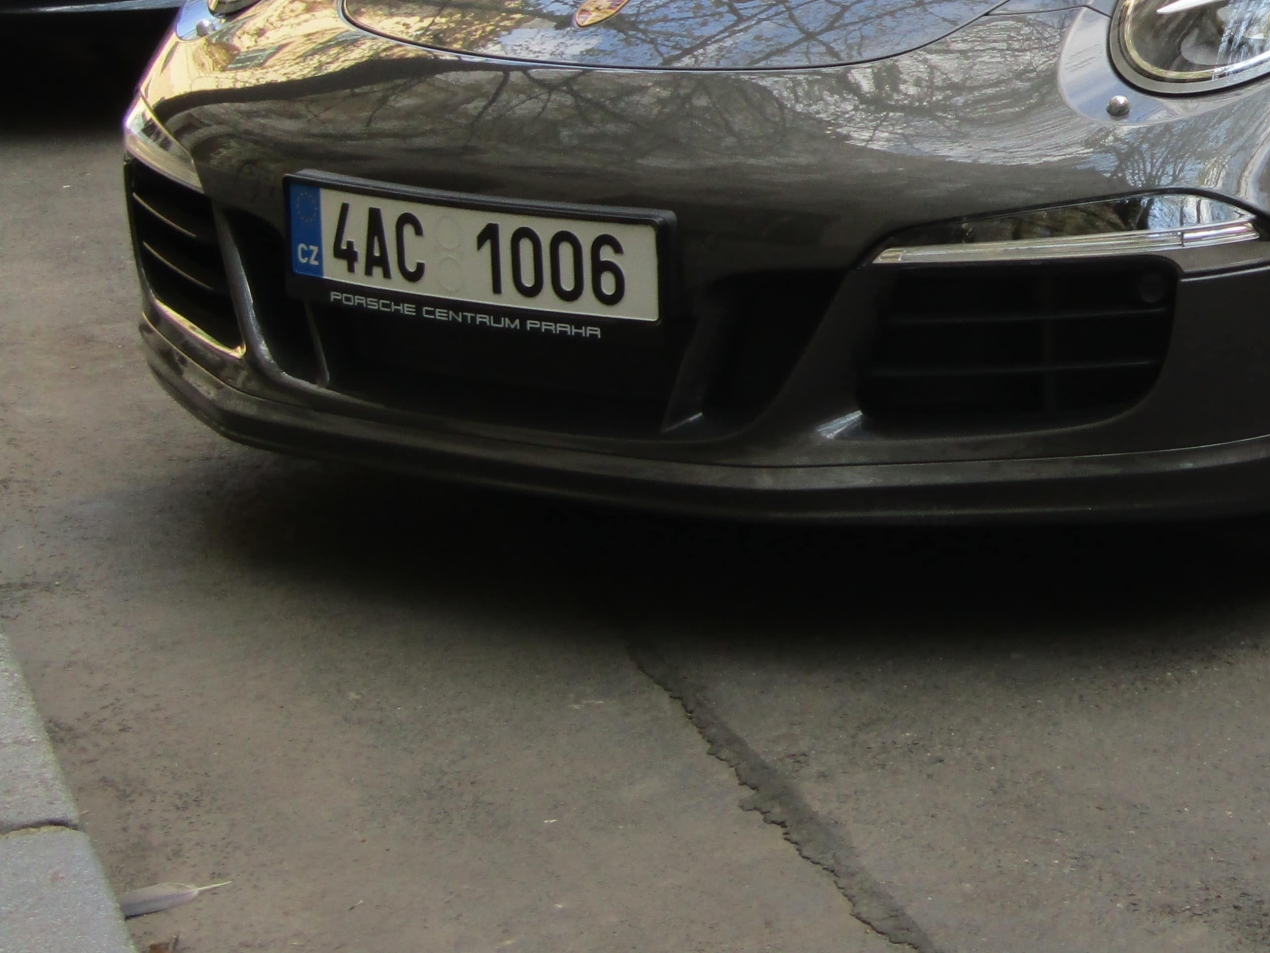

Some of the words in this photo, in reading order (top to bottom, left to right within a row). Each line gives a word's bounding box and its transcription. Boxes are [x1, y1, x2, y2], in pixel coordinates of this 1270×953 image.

[297, 243, 319, 265] CZ
[332, 202, 426, 283] 4AC
[476, 222, 626, 307] 1006
[330, 291, 416, 316] PORSCHE
[422, 306, 520, 330] CENTRUM
[526, 319, 602, 339] PRAHA
